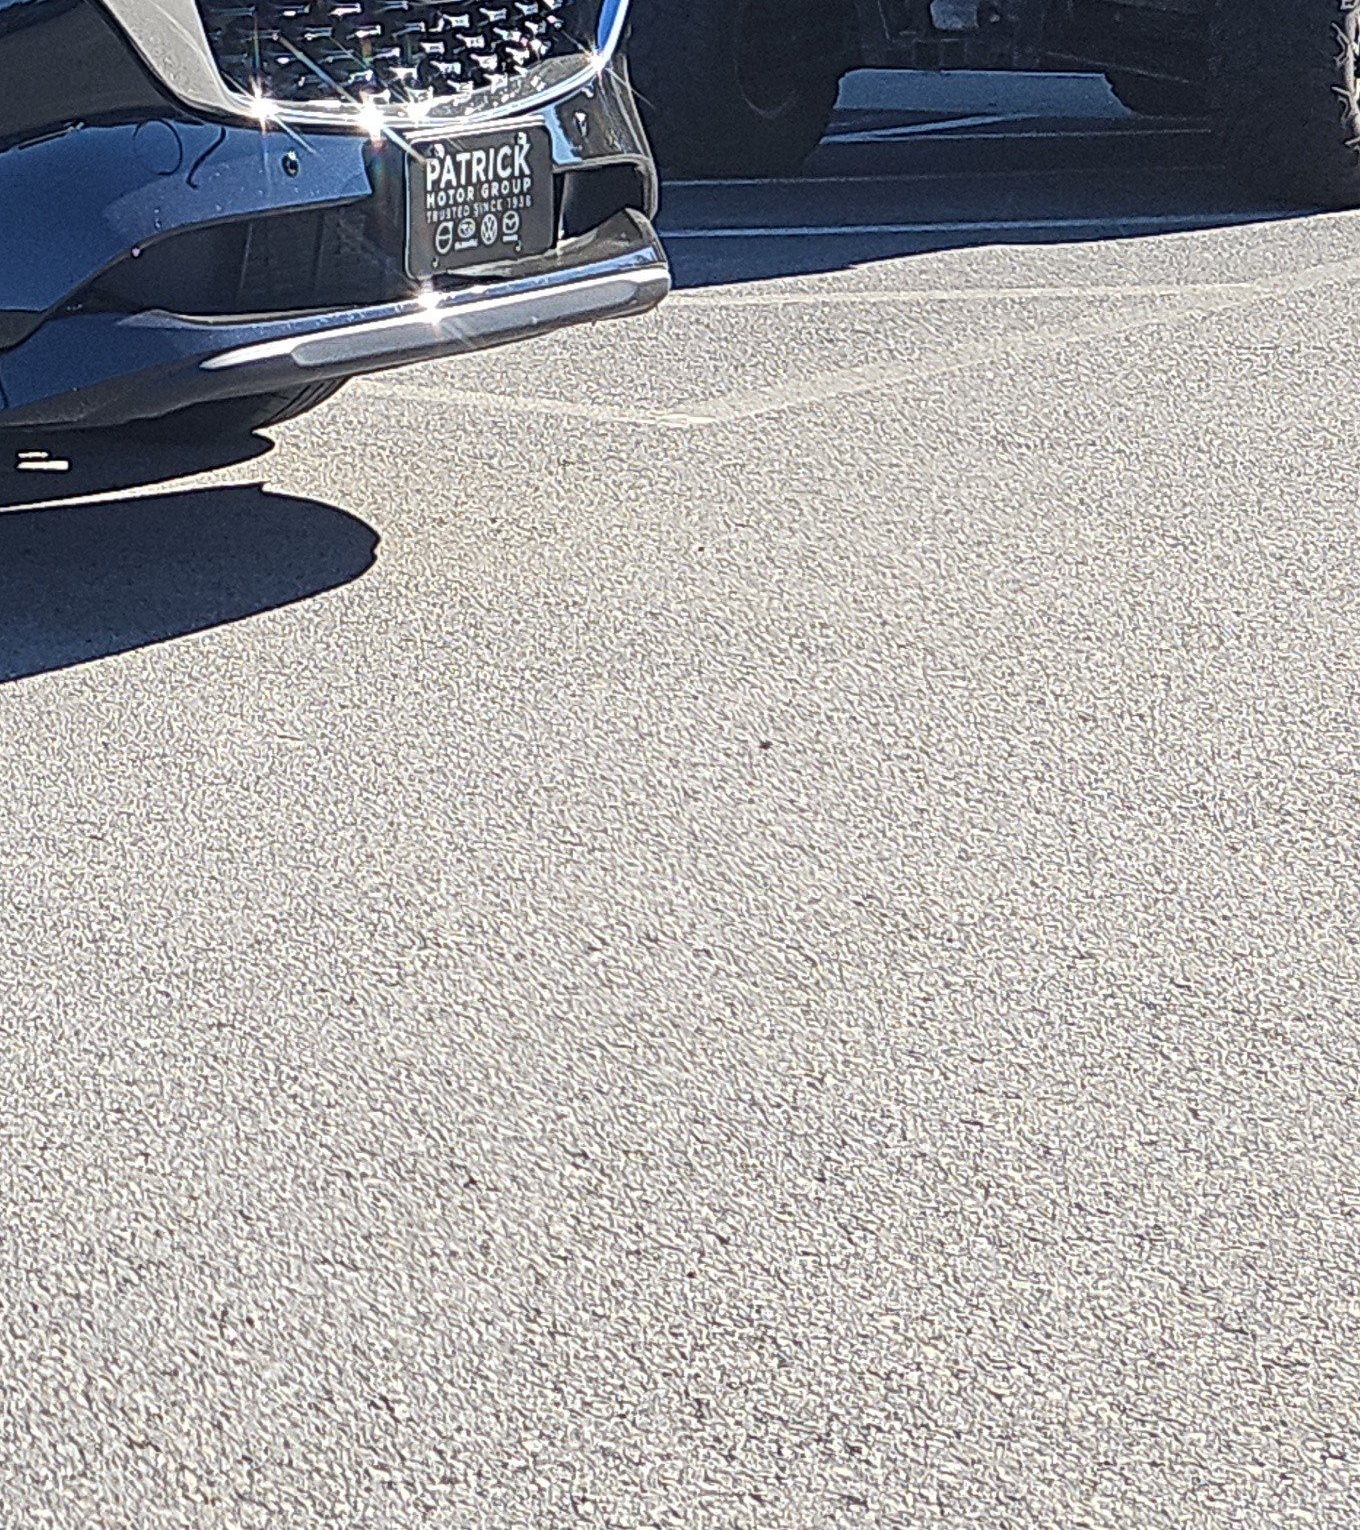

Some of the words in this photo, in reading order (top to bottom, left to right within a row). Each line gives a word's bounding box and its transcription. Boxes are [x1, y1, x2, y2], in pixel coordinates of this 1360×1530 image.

[425, 143, 531, 191] PATRICK
[426, 186, 475, 209] MOTOR
[481, 177, 532, 199] GROUP
[426, 205, 470, 224] TRUSTED
[473, 199, 503, 218] SINCE
